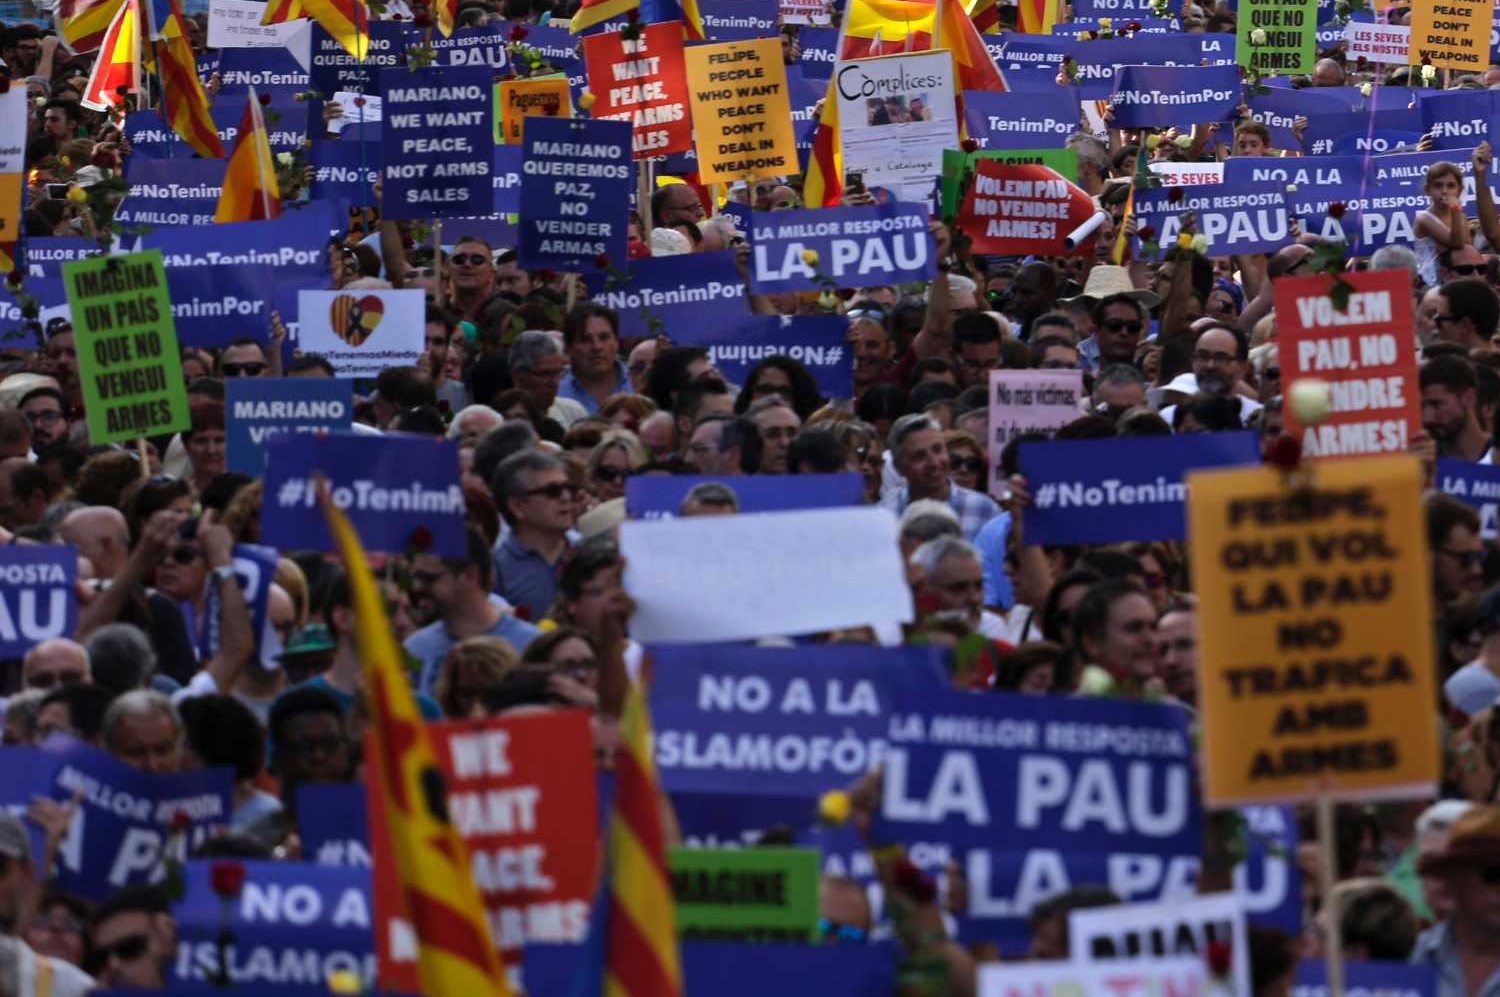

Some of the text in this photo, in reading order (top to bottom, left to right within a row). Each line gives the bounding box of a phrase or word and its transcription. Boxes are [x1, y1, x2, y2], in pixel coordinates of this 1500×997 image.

[1252, 10, 1304, 28] QUE NO
[1433, 5, 1472, 17] PEACE
[1433, 20, 1470, 31] DON'T
[1427, 35, 1472, 47] DEAL IN
[708, 51, 760, 65] FELIPE,
[1251, 53, 1300, 69] ARMES
[1419, 50, 1479, 63] WEAPONS
[612, 57, 659, 80] WANT
[709, 68, 763, 82] PEOPLE
[698, 83, 780, 102] WHO WANT
[837, 65, 943, 101] Còmplices:
[388, 86, 486, 103] MARIANO,
[610, 82, 667, 106] PEACE,
[1112, 88, 1233, 105] #NoTenimPor
[391, 111, 483, 127] WE WANT
[634, 102, 684, 125] ARMS
[718, 104, 765, 118] PEACE
[722, 122, 765, 135] DON'T
[403, 138, 472, 153] PEACE,
[533, 142, 621, 158] MARIANO
[719, 139, 773, 155] DEAL IN
[387, 161, 489, 178] NOT ARMS
[524, 161, 628, 178] QUEREMOS
[712, 156, 785, 173] WEAPONS
[406, 186, 469, 202] SALES
[555, 182, 595, 199] PAZ,
[975, 175, 1072, 200] VOLEM PAU,
[560, 203, 588, 215] NO
[975, 199, 1069, 219] NO VENDRE
[1136, 193, 1284, 214] LA MILLOR RESPOSTA
[536, 221, 611, 236] VENDER
[753, 214, 923, 240] LA MILLOR RESPOSTA
[986, 218, 1056, 239] ARMES!
[1202, 208, 1288, 245] PAU
[539, 242, 605, 254] ARMAS
[755, 233, 928, 282] LA PAU
[74, 262, 157, 299] IMAGINA
[592, 282, 745, 310] #NoTenimPor
[84, 294, 160, 332] UN PAÍS
[93, 330, 161, 368] QUE NO
[95, 366, 166, 400] VENGUI
[997, 384, 1076, 409] No más víctimas,
[105, 400, 172, 434] ARMES
[234, 401, 345, 418] MARIANO
[1222, 532, 1396, 570] QUI VOL
[1232, 575, 1391, 614] LA PAU
[1278, 620, 1339, 651] NO
[1222, 656, 1413, 697] TRAFICA
[1273, 702, 1369, 737] AMB
[890, 714, 1187, 755] LA MILLOR RESPOSTA
[1250, 741, 1396, 781] ARMES
[884, 752, 1187, 837] LA PAU
[241, 884, 370, 927] NO A
